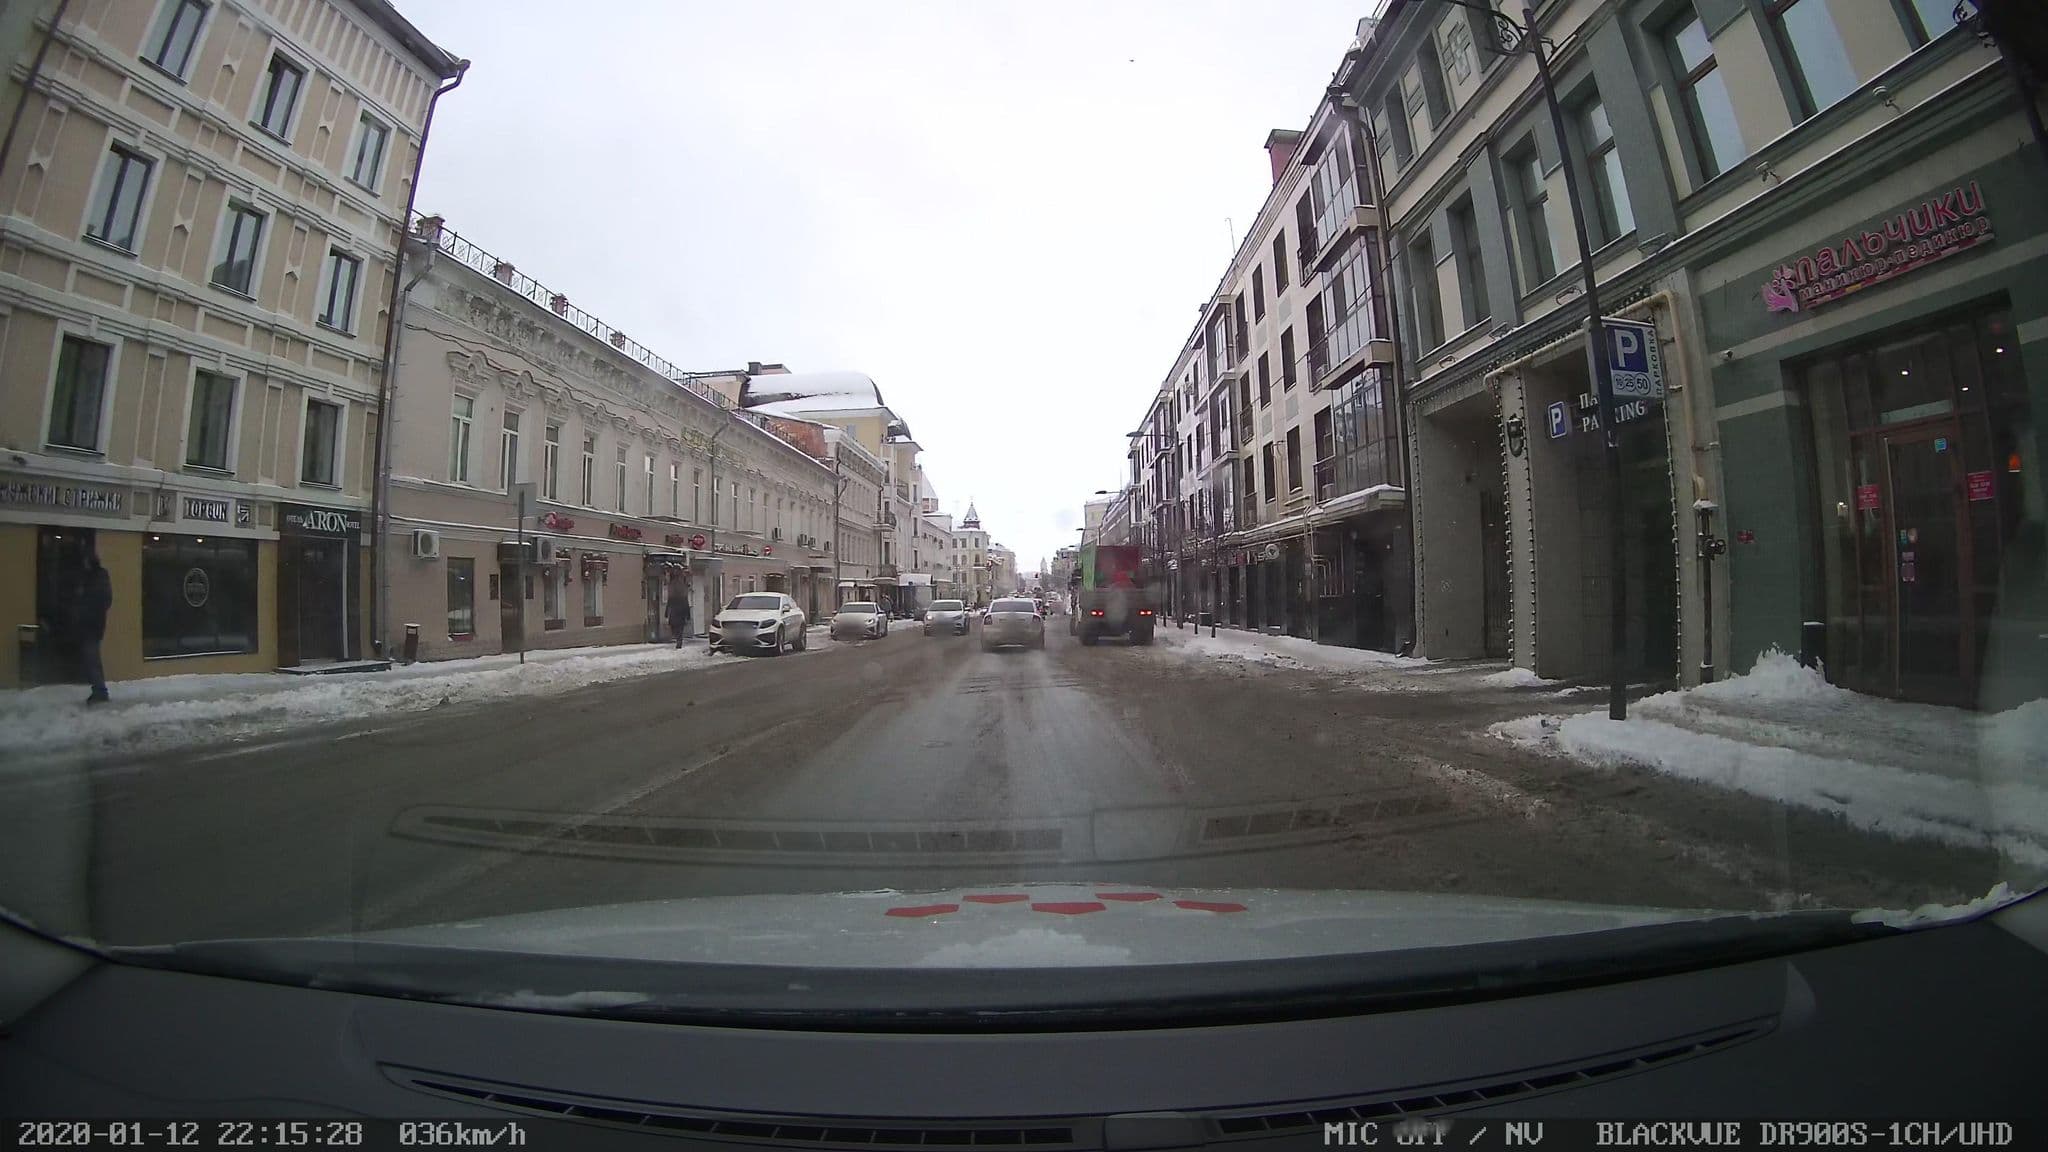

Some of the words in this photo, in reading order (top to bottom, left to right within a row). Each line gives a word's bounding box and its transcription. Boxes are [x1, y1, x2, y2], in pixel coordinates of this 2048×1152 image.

[1614, 329, 1638, 367] P
[1647, 329, 1663, 395] ПАРКОВКА
[1637, 377, 1648, 389] 50
[1582, 400, 1645, 432] PAING
[303, 510, 347, 533] ARON
